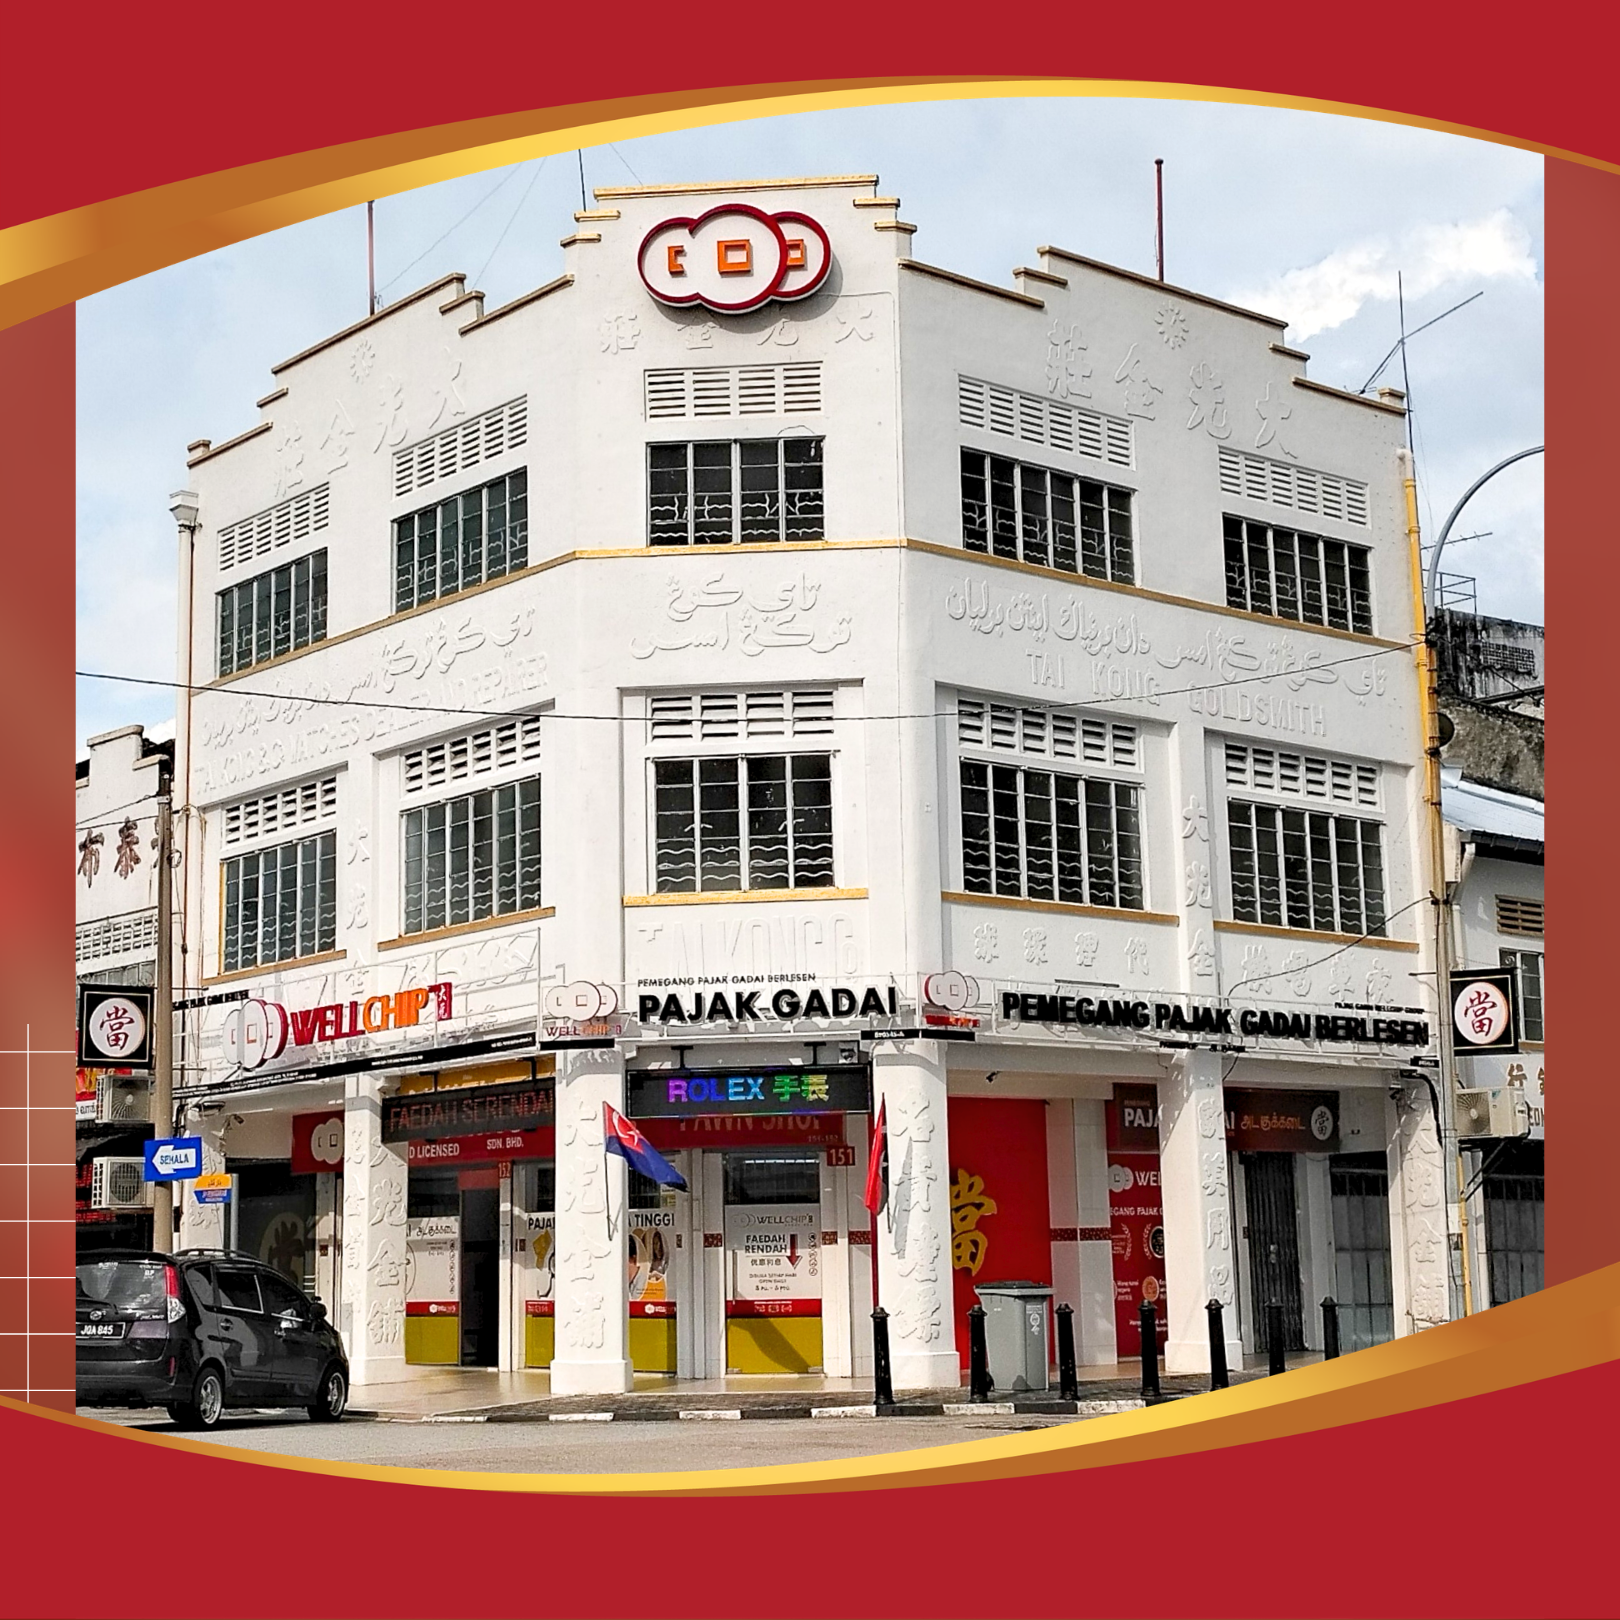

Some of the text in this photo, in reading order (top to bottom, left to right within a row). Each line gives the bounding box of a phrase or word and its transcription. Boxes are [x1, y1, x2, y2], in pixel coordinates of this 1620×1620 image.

[1025, 649, 1327, 738] TAI KONG GOLDSMITH
[637, 971, 817, 988] PEMEGANG PAJAK GADAI BERLESEN
[638, 983, 898, 1024] PAJAK GADAI
[1002, 991, 1150, 1028] PEMEGANG
[1154, 1003, 1231, 1034] PAJAK
[1238, 1009, 1310, 1039] GADAI
[1314, 1014, 1430, 1049] BERLESEN
[1463, 990, 1498, 1037] 當
[99, 1005, 135, 1051] 當
[668, 1077, 766, 1103] ROLEX
[389, 1099, 458, 1133] FAEDAH
[417, 1143, 460, 1159] LICENSED
[506, 1136, 524, 1149] BHD.
[830, 1148, 853, 1166] 151
[634, 1212, 675, 1227] TINGGI
[745, 1234, 786, 1244] FAEDAH
[744, 1244, 787, 1254] RENDAH
[97, 1325, 114, 1335] 845
